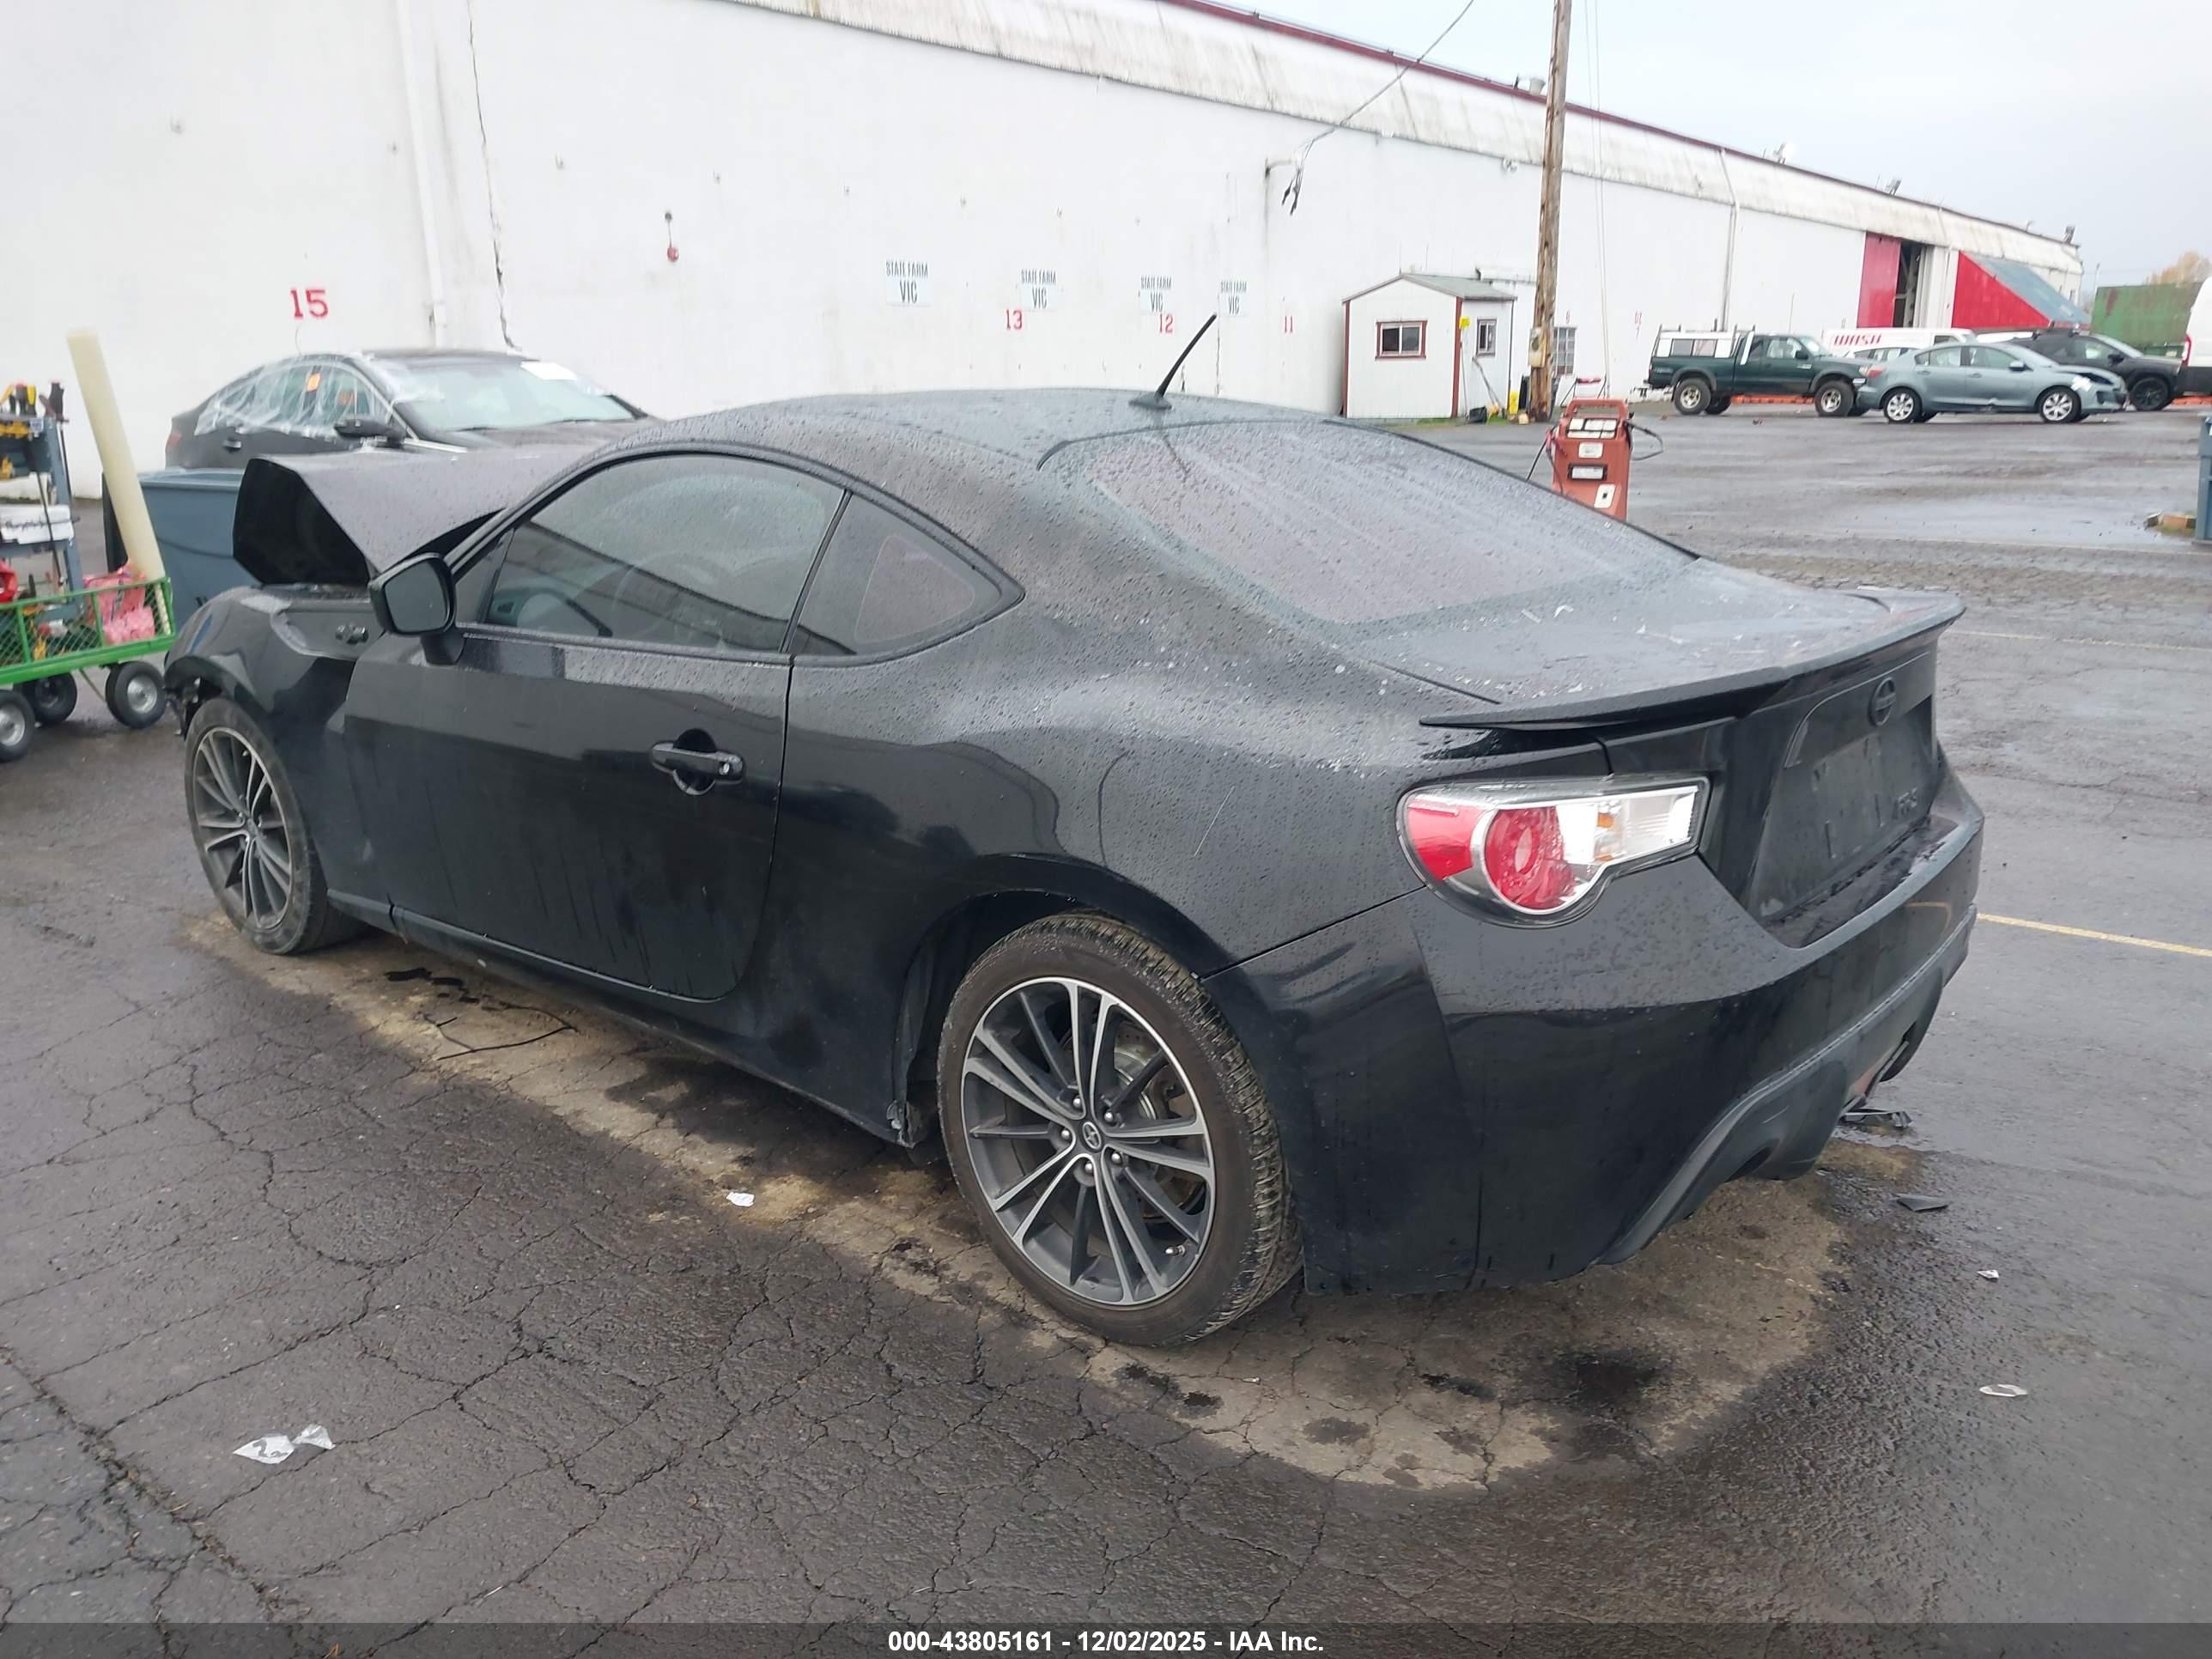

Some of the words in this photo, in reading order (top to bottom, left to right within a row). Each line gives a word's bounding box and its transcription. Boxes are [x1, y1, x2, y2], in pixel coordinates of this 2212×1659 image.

[899, 280, 919, 304] VIC
[1031, 286, 1047, 309] VIC
[1150, 291, 1163, 313] VIC
[290, 289, 329, 319] 15
[1228, 295, 1240, 315] VIC
[1006, 309, 1023, 331] 13
[1159, 313, 1174, 334] 12
[1284, 315, 1293, 334] 11
